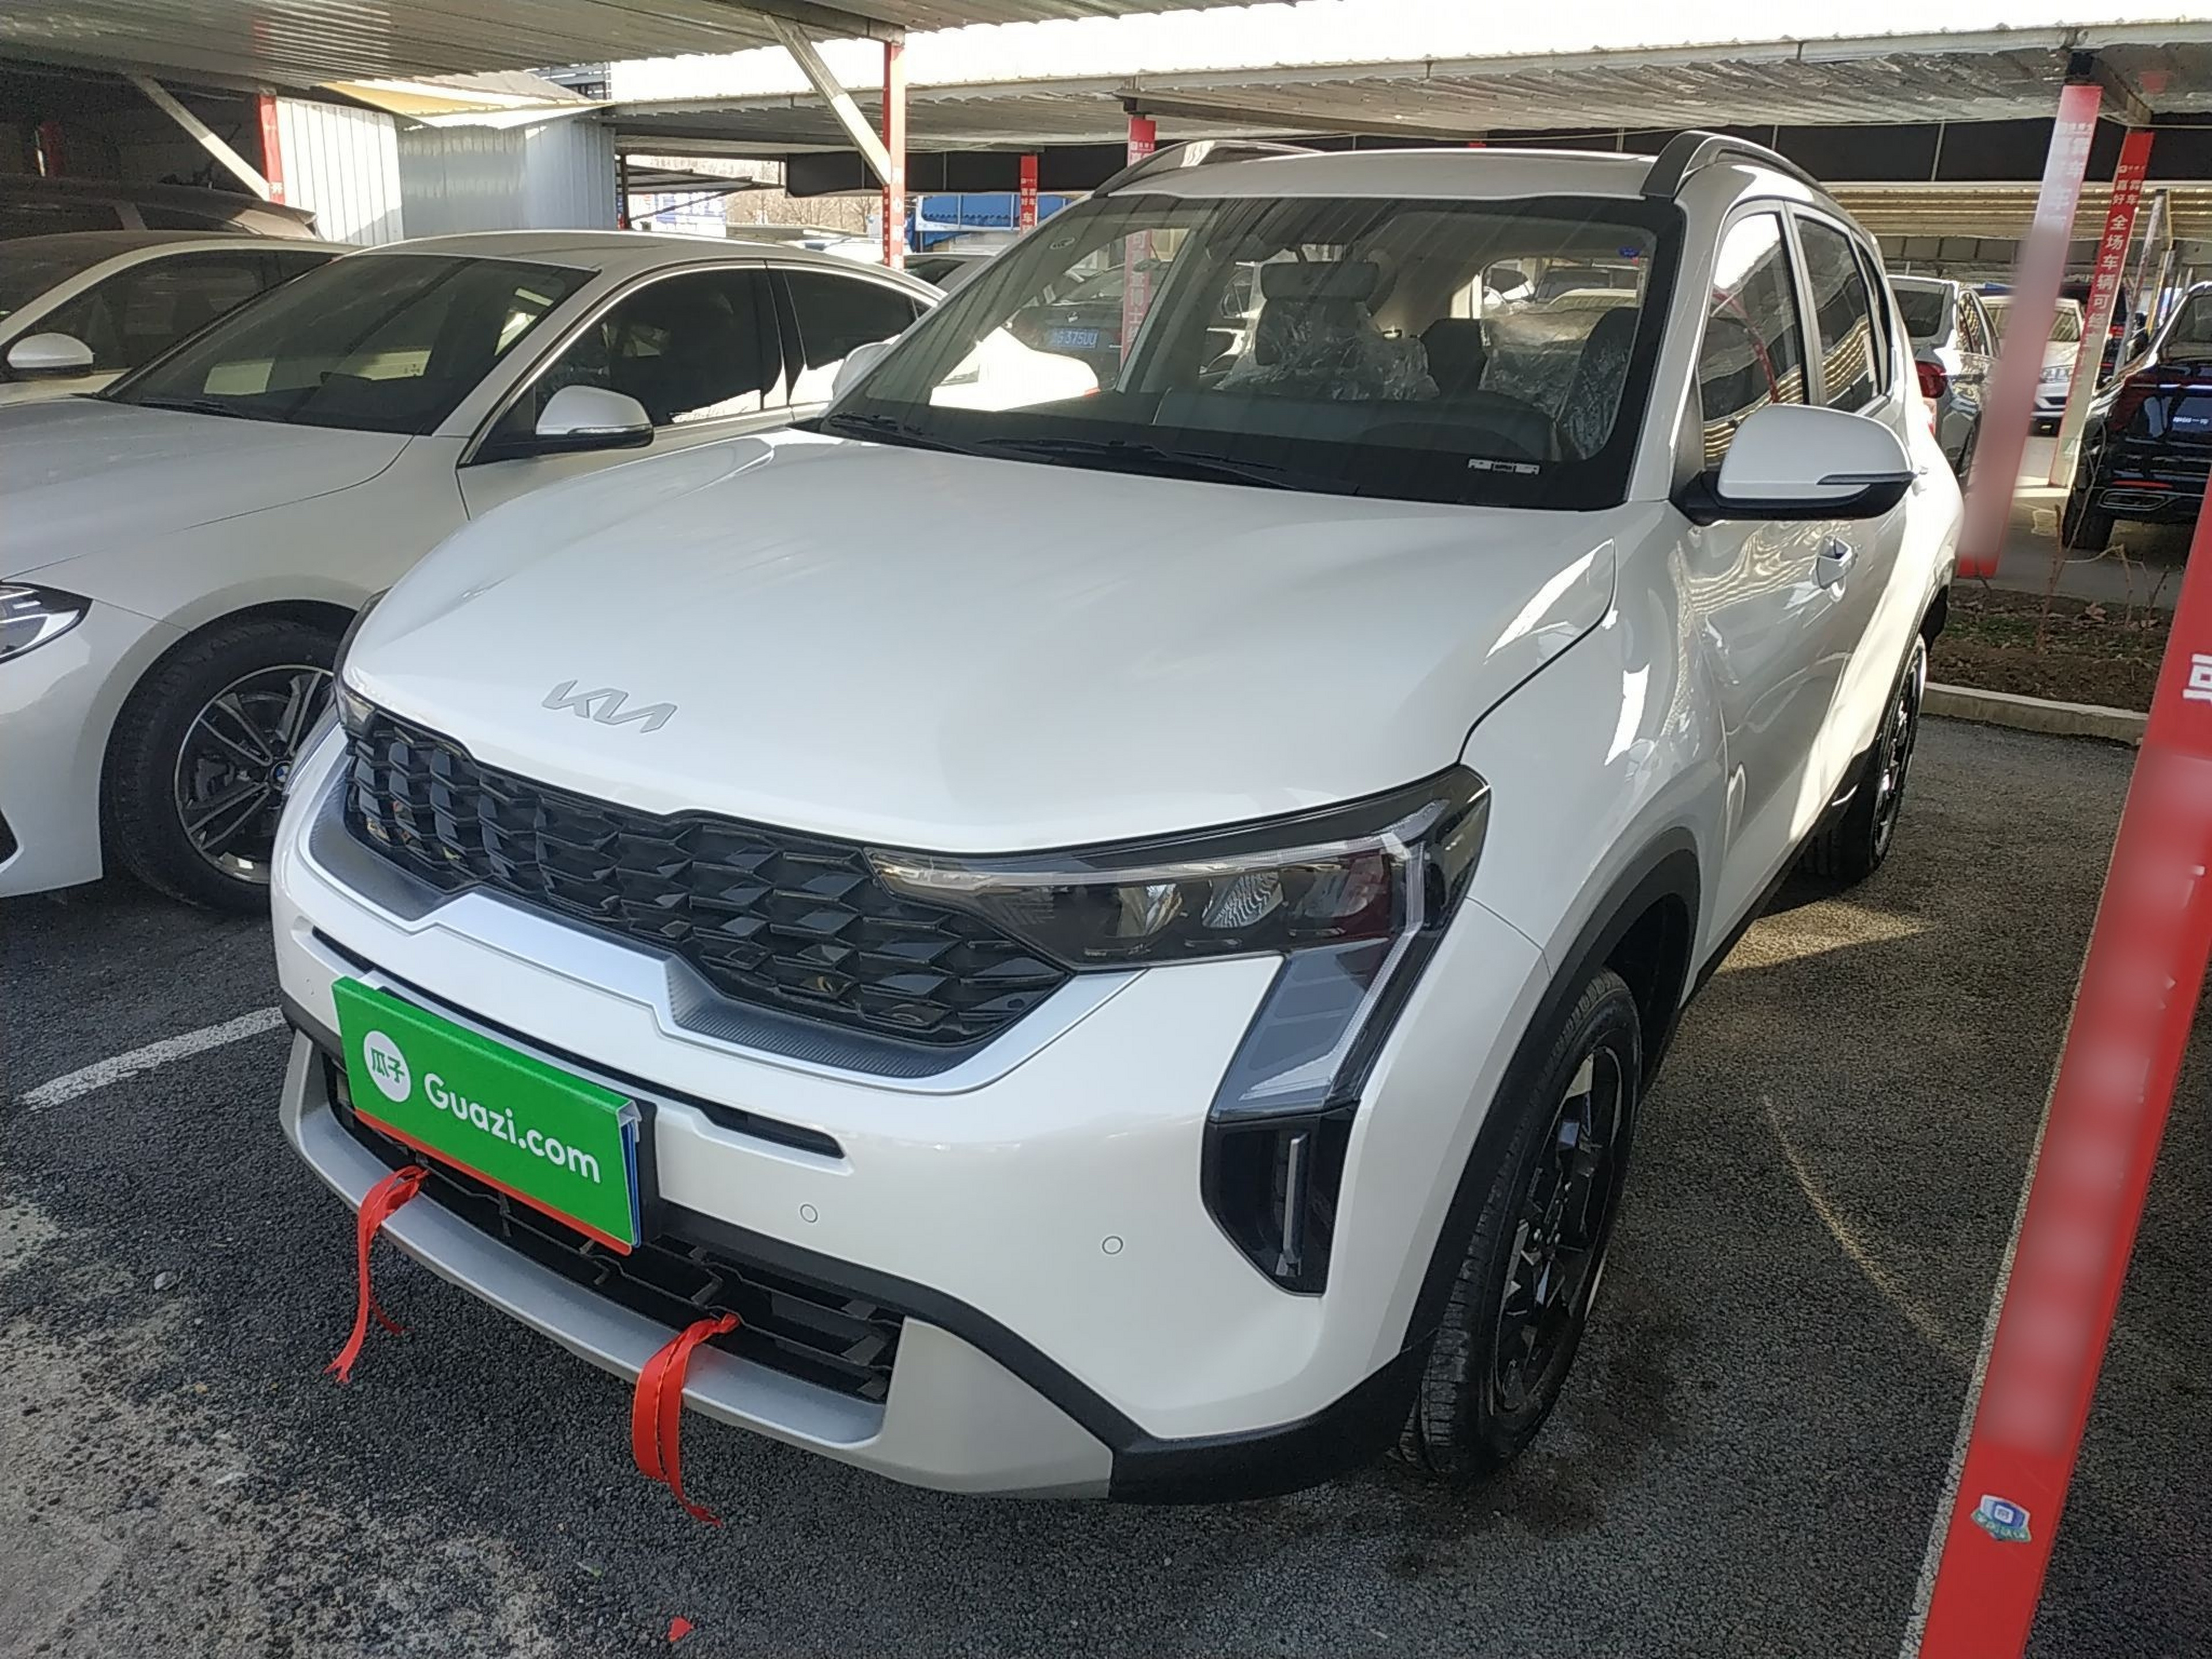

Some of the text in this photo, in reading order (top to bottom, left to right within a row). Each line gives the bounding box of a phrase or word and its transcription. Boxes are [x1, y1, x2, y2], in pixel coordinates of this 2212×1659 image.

[541, 679, 678, 733] KIA
[370, 1047, 405, 1084] 瓜子
[424, 1073, 601, 1184] Guazi.com
